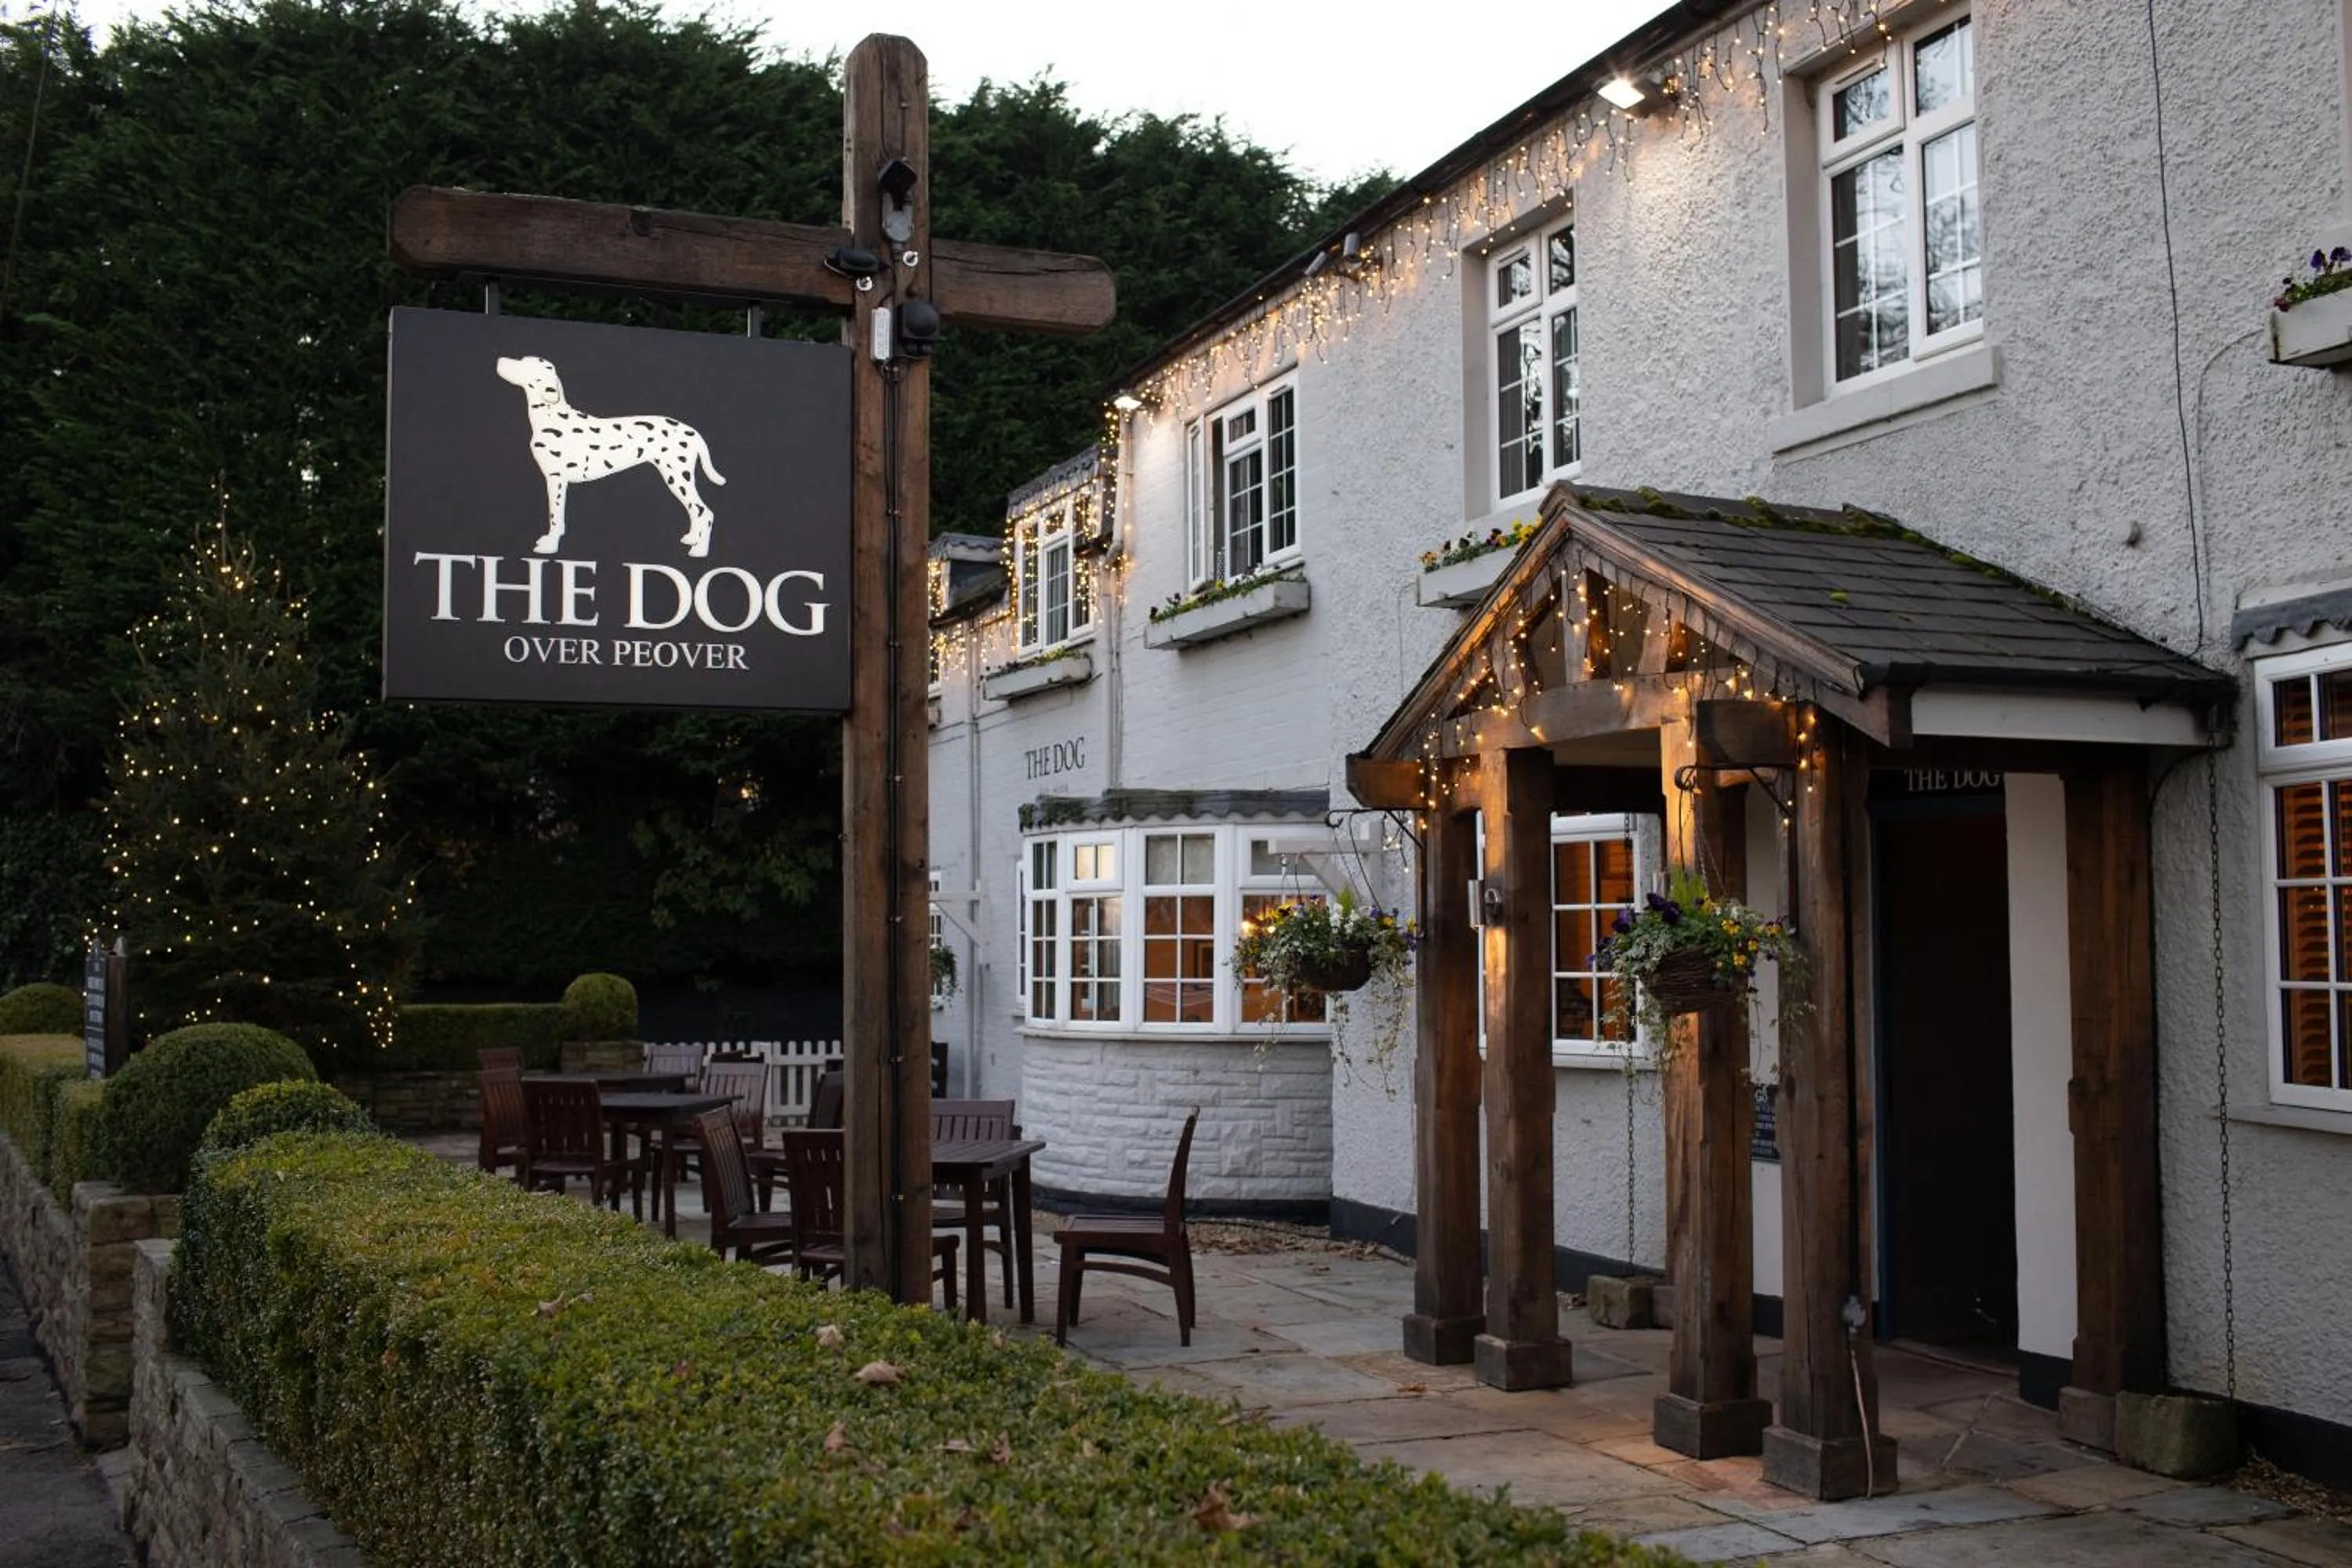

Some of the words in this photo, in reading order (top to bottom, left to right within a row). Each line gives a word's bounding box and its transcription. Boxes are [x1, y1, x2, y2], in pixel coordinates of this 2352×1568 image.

[413, 551, 599, 627] THE
[622, 561, 831, 637] DOG
[503, 635, 603, 666] OVER
[612, 637, 750, 670] PEOVER
[1024, 746, 1051, 780] THE
[1053, 736, 1085, 774] DOG
[1904, 768, 1948, 791] THE
[1953, 769, 2001, 789] DOG
